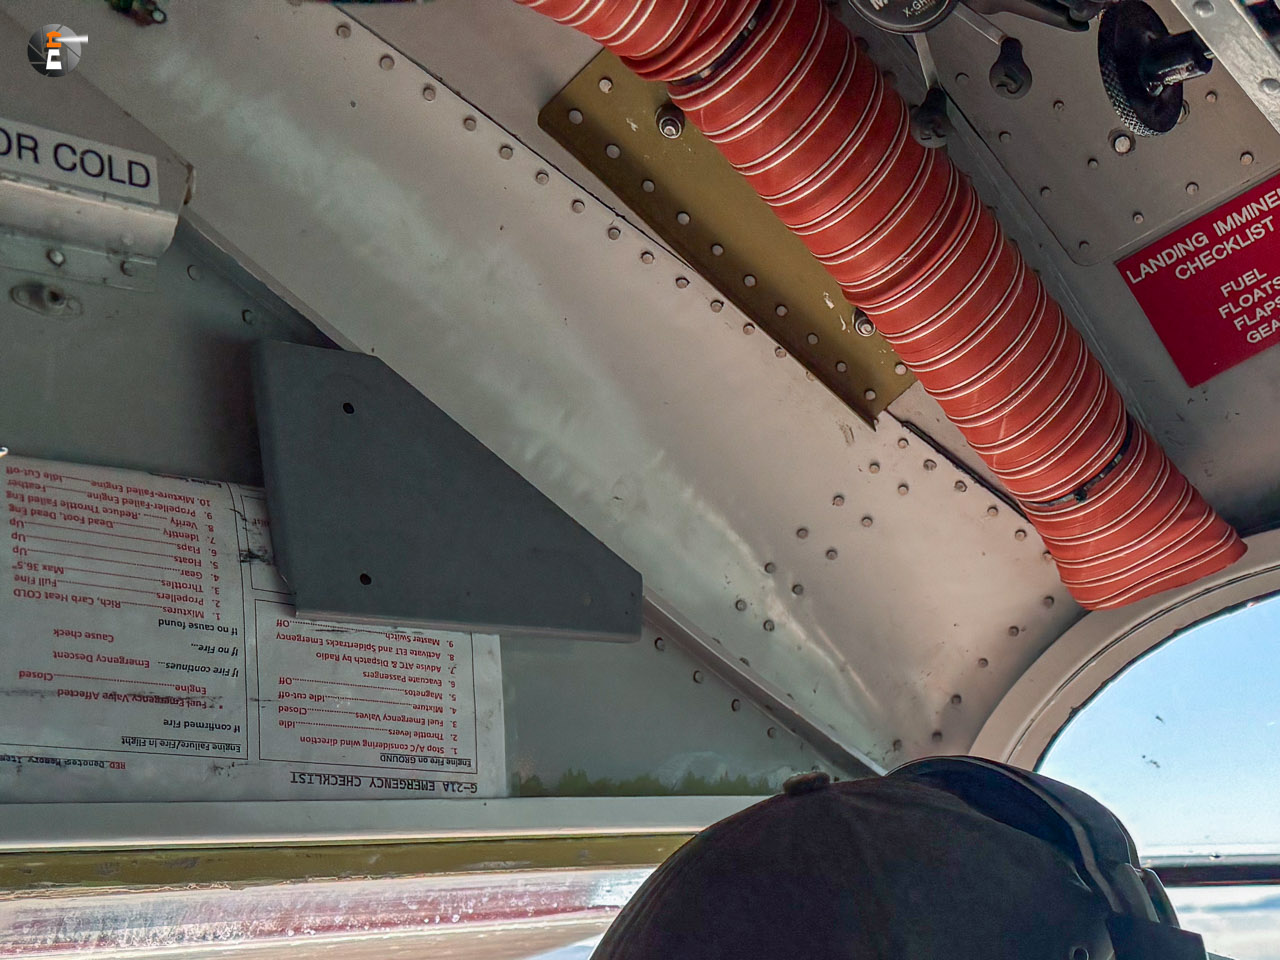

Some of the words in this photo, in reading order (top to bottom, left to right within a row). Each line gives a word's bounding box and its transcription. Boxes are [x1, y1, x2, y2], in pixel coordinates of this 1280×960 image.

[53, 142, 151, 188] COLD
[1175, 216, 1275, 280] CHECKLIST
[1126, 231, 1210, 284] LANDING
[1220, 268, 1267, 297] FUEL
[7, 480, 46, 492] Feather
[126, 486, 195, 505] Mixture-Failed
[60, 500, 99, 514] Throttle
[122, 498, 196, 517] Propeller-Failed
[163, 529, 199, 541] Identify
[161, 580, 203, 592] Throttles
[13, 588, 42, 599] COLD
[156, 593, 204, 606] Propellers
[162, 607, 204, 619] Mixtures
[159, 619, 186, 629] found
[53, 629, 82, 640] check
[84, 632, 114, 643] Cause
[276, 633, 323, 646] Emergency
[385, 633, 411, 642] Switch
[326, 639, 376, 653] Spidertracks
[413, 636, 440, 646] Master
[53, 651, 93, 662] Descent
[316, 652, 340, 661] Radio
[410, 649, 440, 660] Activate
[96, 654, 150, 668] Emergency
[354, 655, 389, 667] Dispatch
[416, 664, 441, 673] Advise
[19, 670, 54, 681] Closed
[362, 671, 406, 682] Passengers
[408, 677, 442, 687] Evacuate
[57, 689, 99, 699] Affected
[175, 685, 207, 695] Engine
[278, 691, 307, 699] cut-off
[404, 689, 443, 700] Magnetos
[278, 706, 307, 715] Closed
[412, 704, 443, 713] Mixture
[355, 712, 381, 721] Valves
[383, 714, 425, 725] Emergency
[184, 720, 231, 731] confirmed
[388, 729, 411, 738] levers
[414, 731, 444, 740] Throttle
[300, 736, 338, 746] direction
[362, 740, 408, 750] considering
[212, 743, 240, 753] Engine
[427, 744, 445, 754] Stop
[380, 754, 416, 763] GROUND
[290, 773, 362, 787] CHECKLIST
[370, 777, 435, 791] EMERGENCY
[443, 781, 478, 793] G-21A
